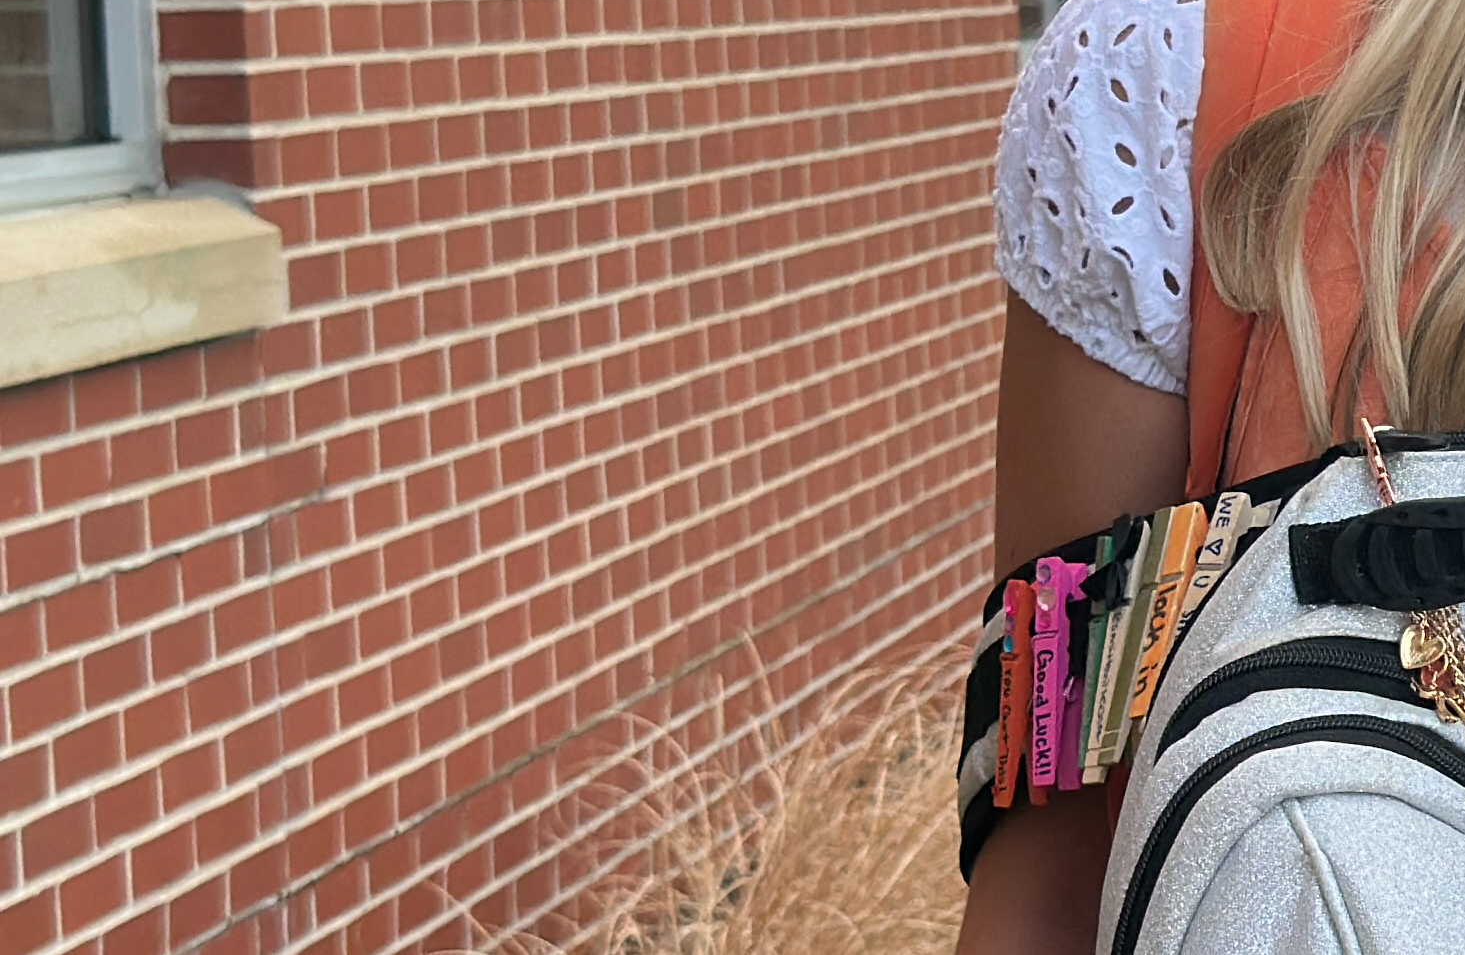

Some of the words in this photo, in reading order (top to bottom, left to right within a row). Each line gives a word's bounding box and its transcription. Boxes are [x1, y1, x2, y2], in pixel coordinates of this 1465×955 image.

[1215, 495, 1238, 529] WE
[1035, 649, 1053, 708] Good
[1034, 713, 1052, 776] Luck!!
